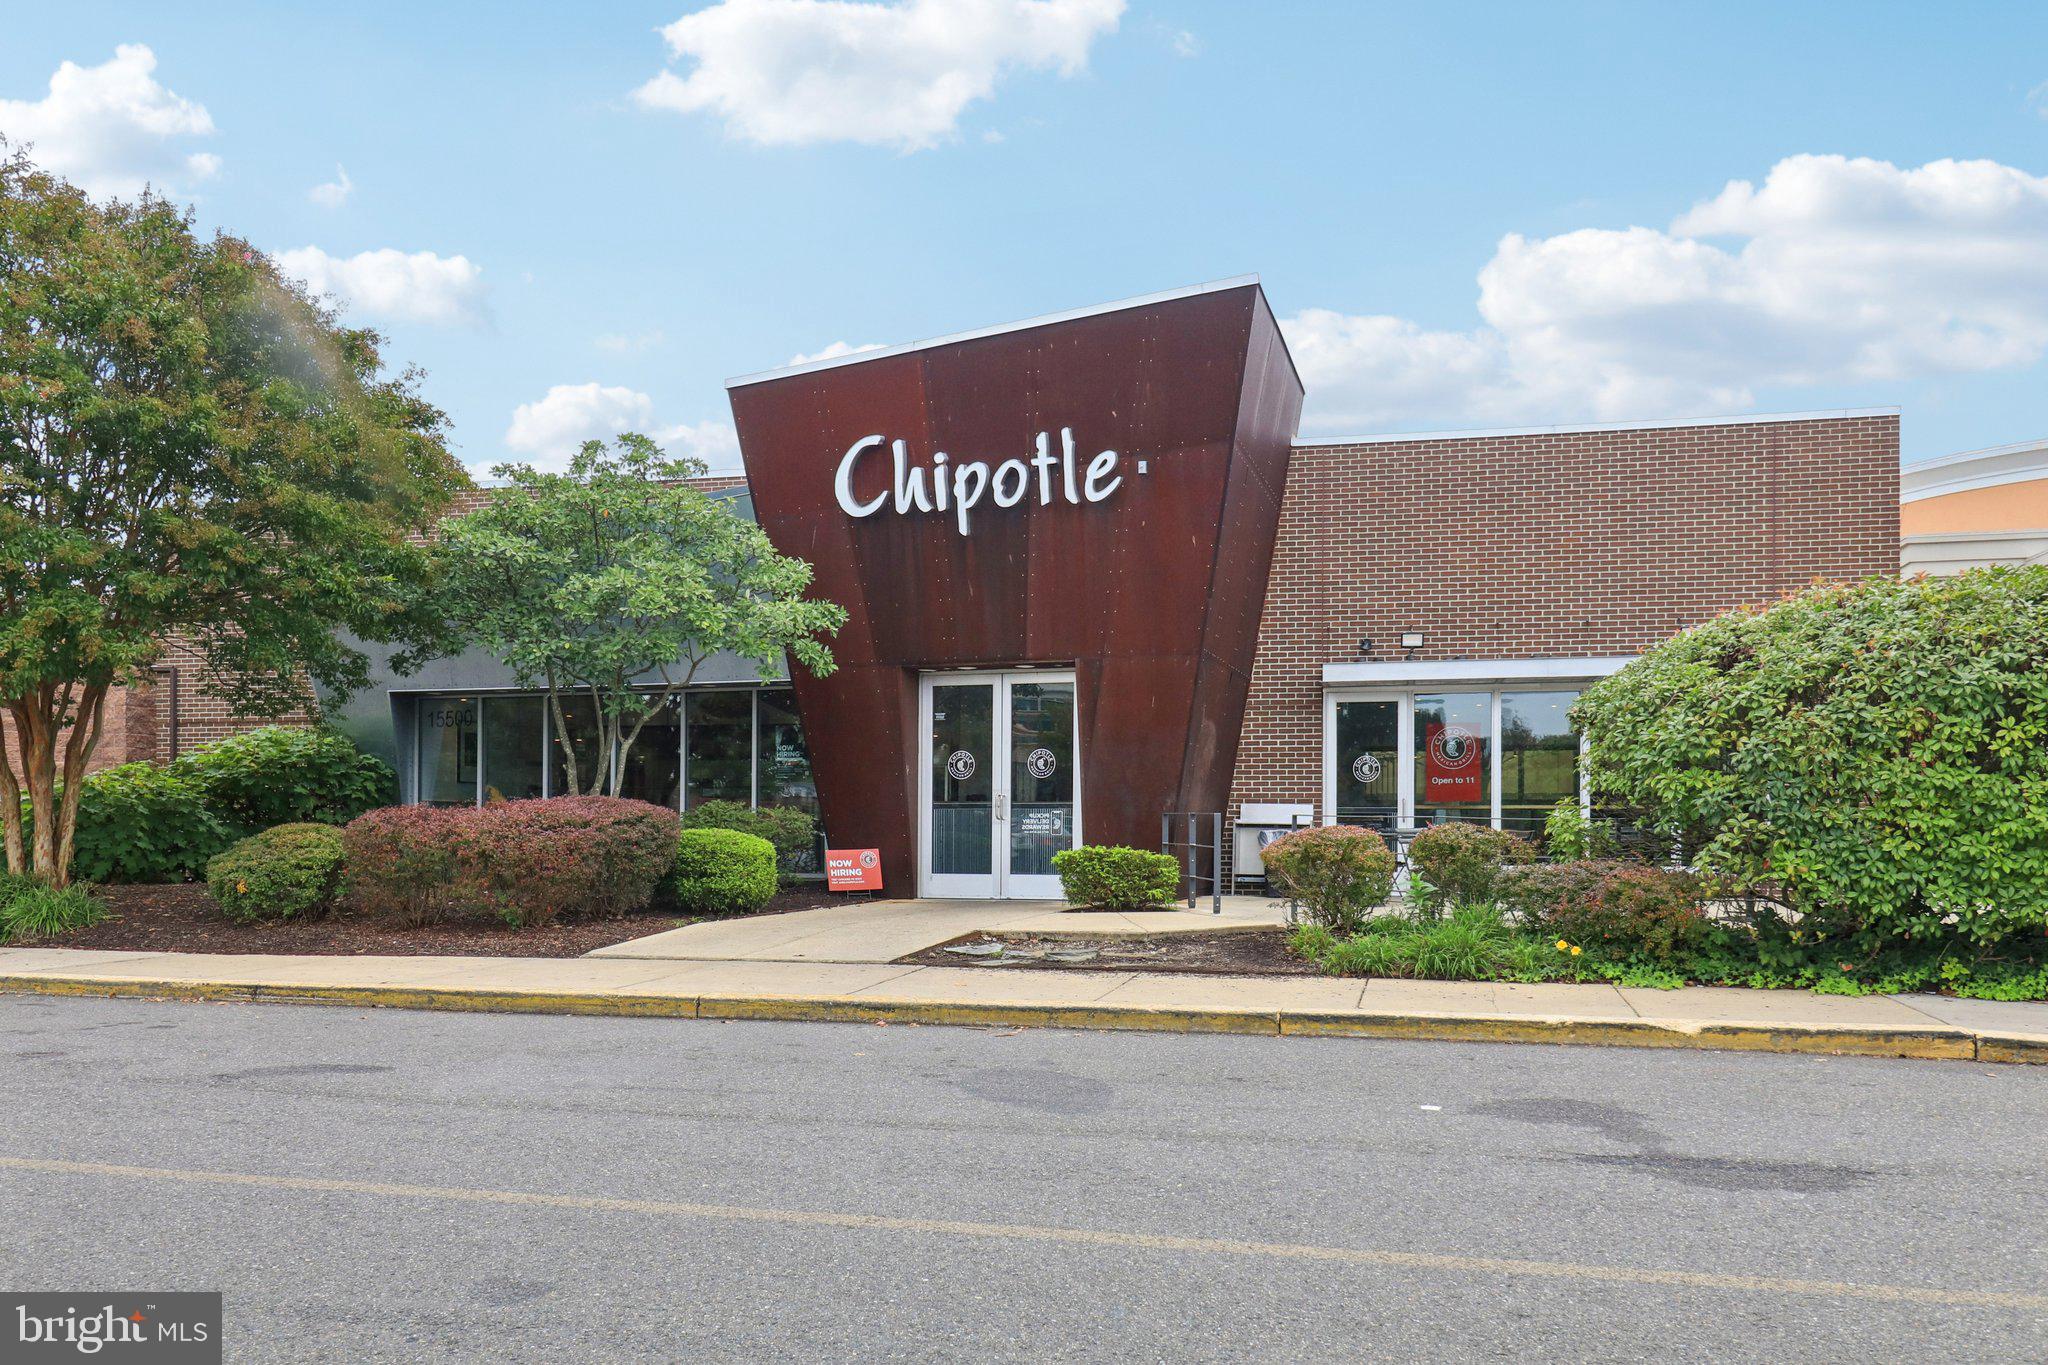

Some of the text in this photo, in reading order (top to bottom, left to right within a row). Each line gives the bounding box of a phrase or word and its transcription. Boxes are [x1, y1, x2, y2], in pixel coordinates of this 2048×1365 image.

[834, 426, 1123, 537] Chipotle
[428, 709, 473, 728] 15500
[1434, 729, 1473, 745] CHIPOTLE
[776, 744, 794, 752] NOW
[776, 751, 801, 759] HIRING
[1431, 776, 1475, 786] Open to 11
[829, 859, 852, 868] NOW
[830, 868, 863, 877] HIRING
